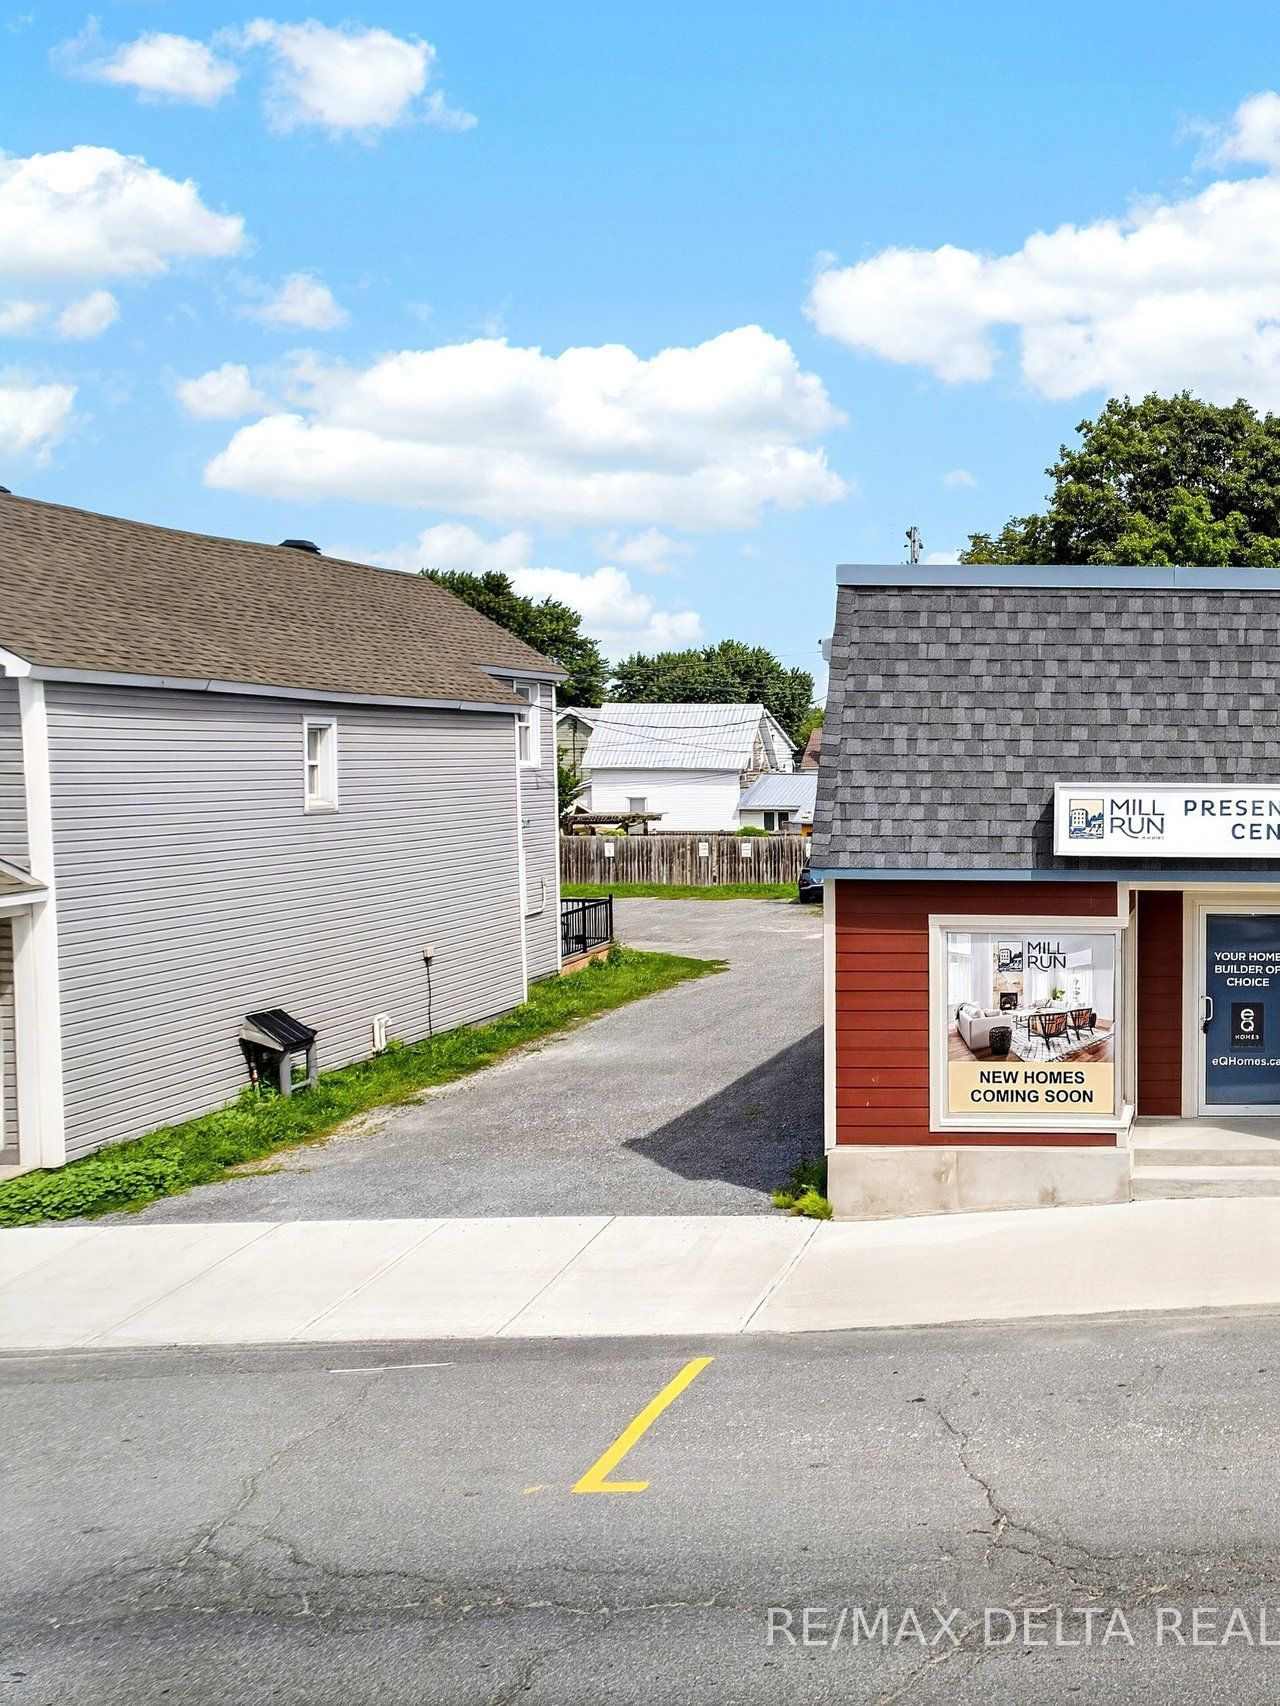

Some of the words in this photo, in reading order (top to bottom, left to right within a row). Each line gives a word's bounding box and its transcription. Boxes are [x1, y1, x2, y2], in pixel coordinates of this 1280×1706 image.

[1110, 799, 1165, 816] MILL
[1110, 817, 1165, 839] RUN
[1027, 941, 1066, 955] MILL
[1214, 952, 1246, 961] YOUR
[1027, 955, 1066, 972] RUN
[1214, 965, 1263, 974] BUILDER
[1226, 978, 1270, 987] CHOICE
[979, 1071, 1019, 1084] NEW
[1024, 1071, 1085, 1084] HOMES
[970, 1090, 1039, 1103] COMING
[1044, 1090, 1093, 1103] SOON
